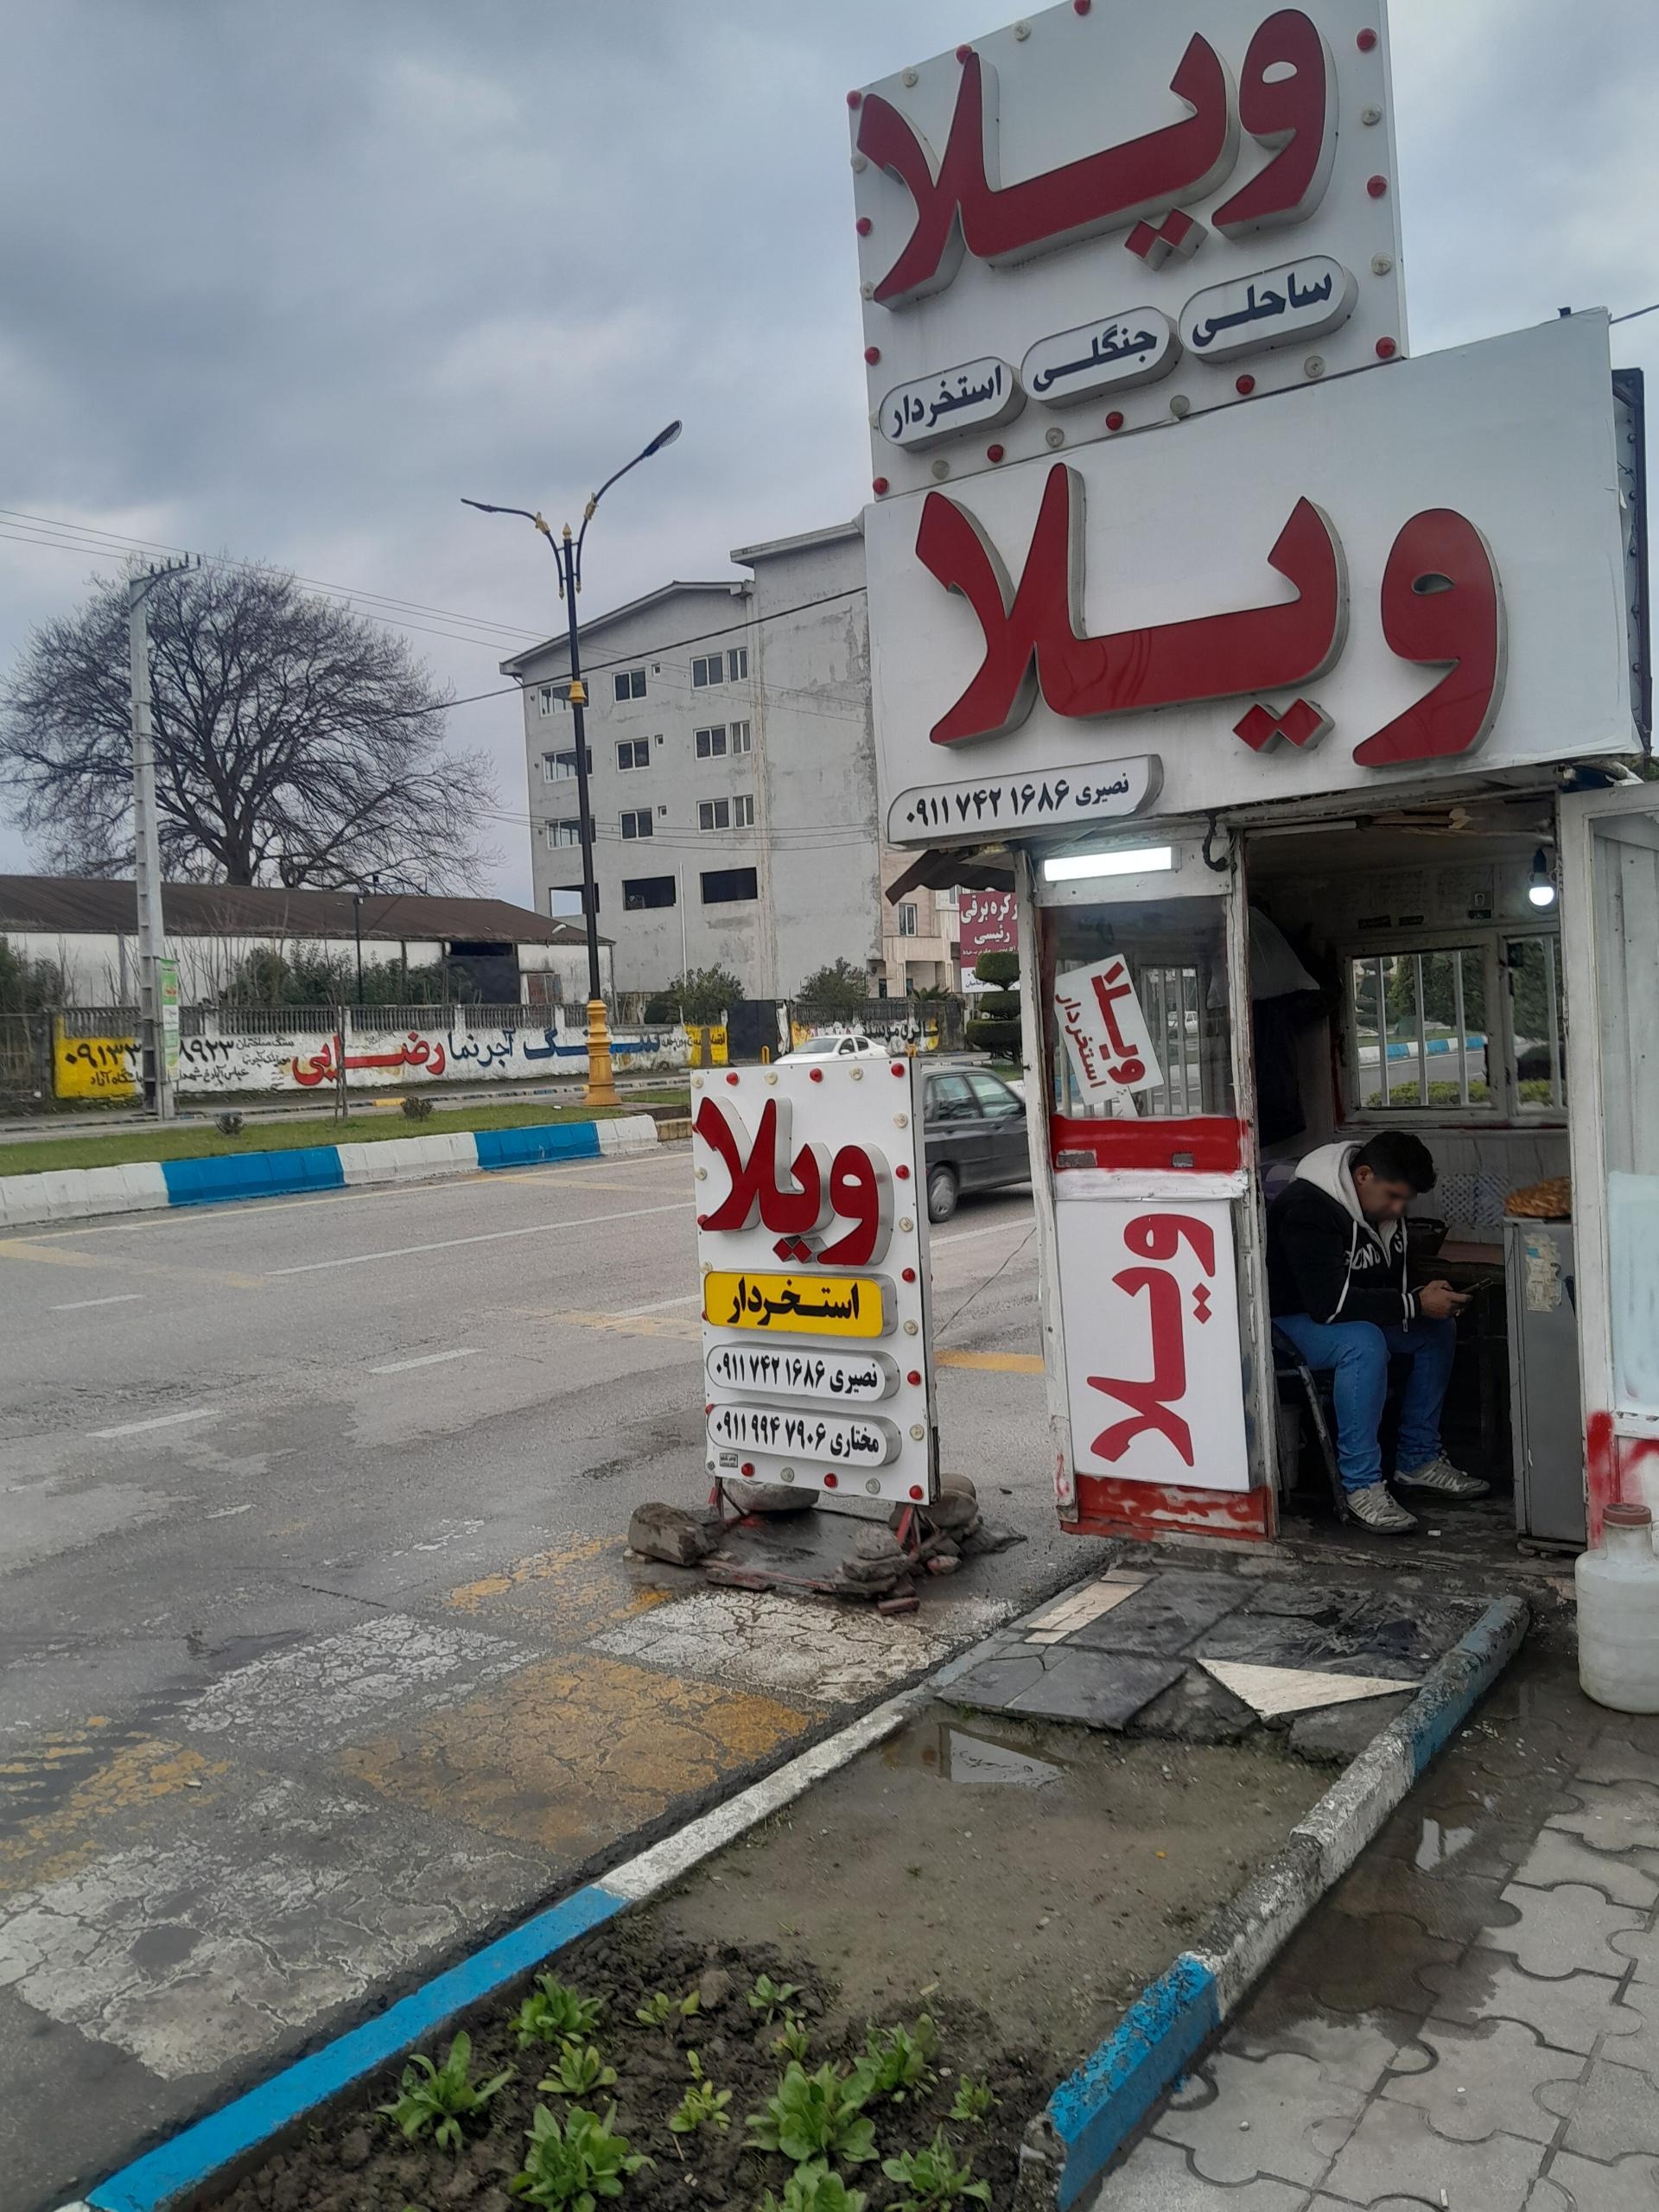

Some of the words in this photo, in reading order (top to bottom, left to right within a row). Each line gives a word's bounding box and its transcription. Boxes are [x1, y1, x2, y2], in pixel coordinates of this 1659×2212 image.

[857, 9, 1329, 303] ویلا
[1192, 270, 1332, 346] ساحلی
[1033, 327, 1157, 392] جنگلی
[891, 366, 1002, 438] استخردار
[916, 462, 1497, 767] ویلا
[1076, 772, 1128, 806] نصیری
[1054, 994, 1107, 1088] استخردار
[1090, 961, 1146, 1084] ویلا
[696, 1096, 879, 1266] ویلا
[728, 1275, 859, 1325] استخردار
[1086, 1212, 1216, 1467] ویلا
[830, 1363, 878, 1394] نصیری
[830, 1425, 879, 1458] مختاری
